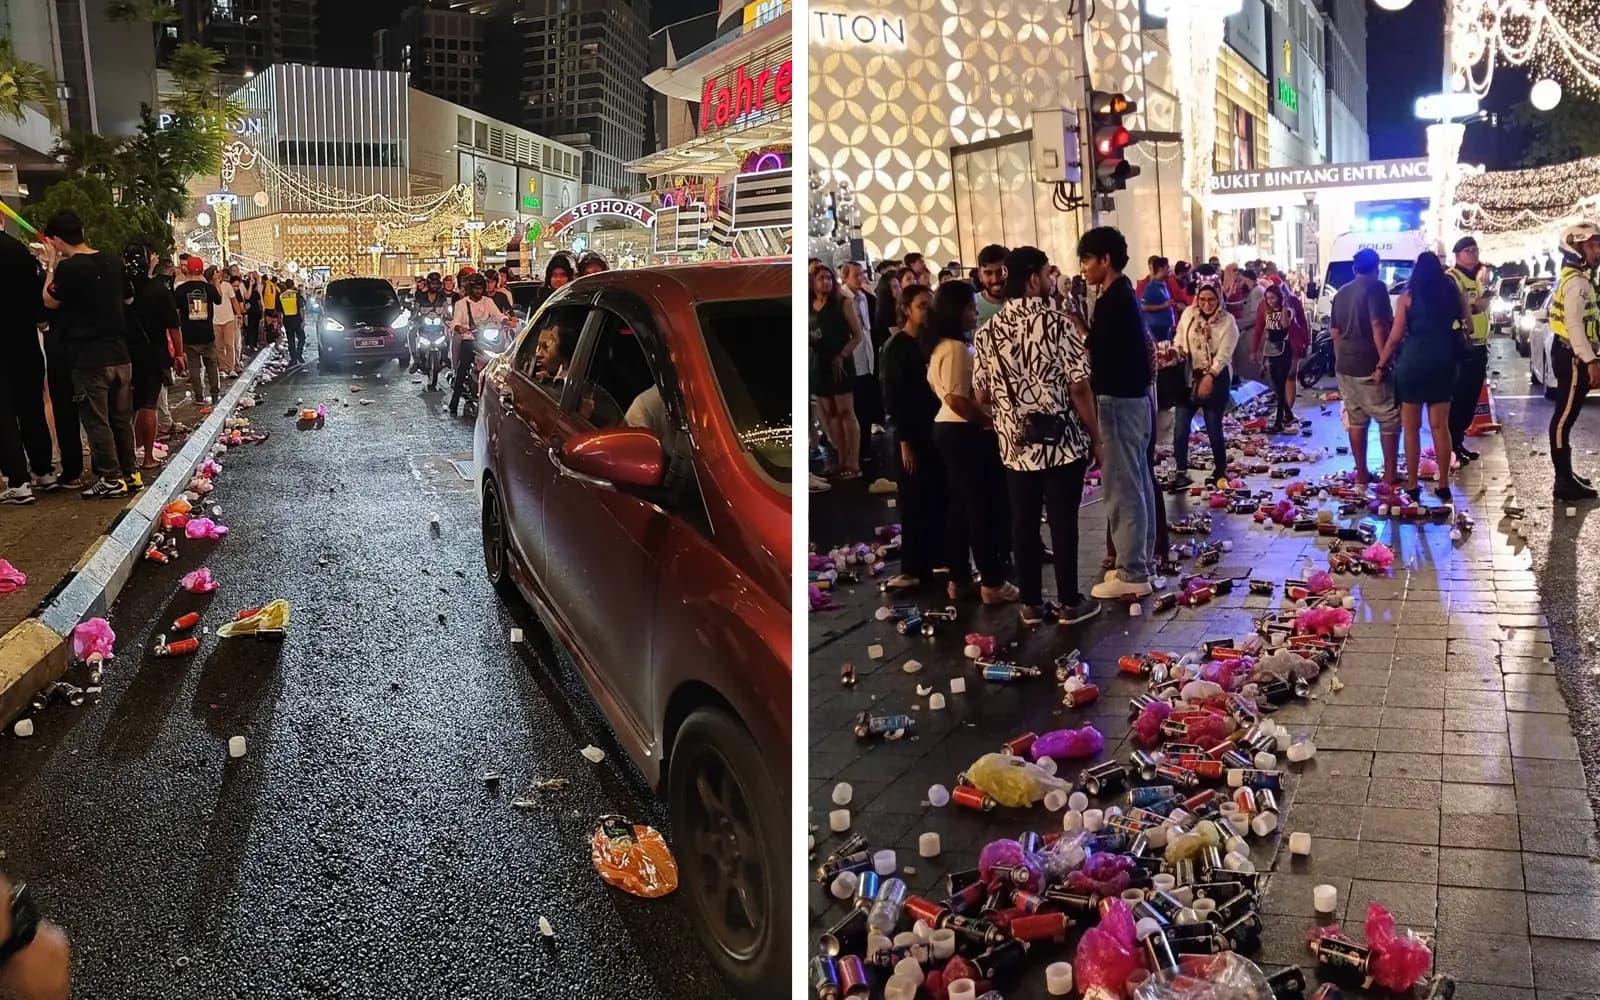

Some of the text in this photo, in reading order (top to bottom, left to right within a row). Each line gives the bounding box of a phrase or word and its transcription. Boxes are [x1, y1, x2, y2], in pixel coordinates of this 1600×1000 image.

[813, 11, 905, 44] TTON
[1210, 161, 1432, 190] BUKIT BINTANG ENTRANC
[571, 200, 643, 220] SEPHORA
